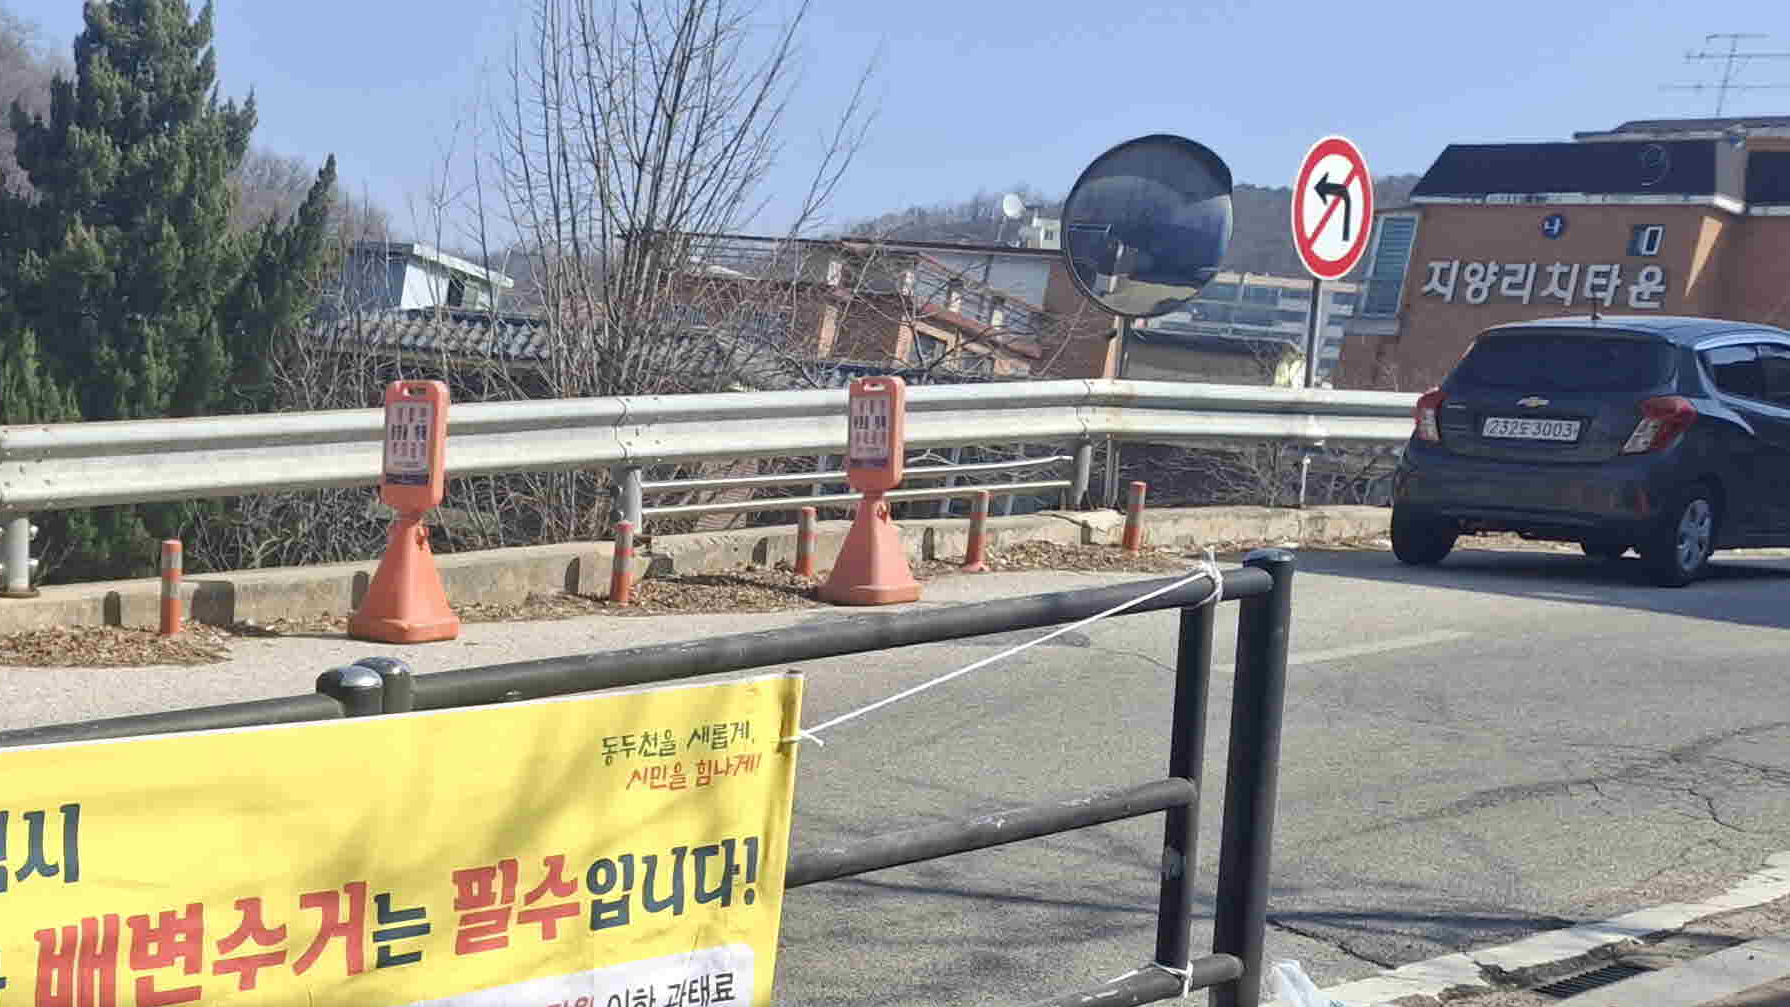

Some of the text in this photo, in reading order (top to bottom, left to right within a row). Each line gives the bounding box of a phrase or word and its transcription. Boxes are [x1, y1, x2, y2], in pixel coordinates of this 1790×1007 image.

[1420, 259, 1667, 310] 지양리치타운
[601, 728, 677, 766] 동두천을
[625, 752, 763, 791] 시민을 힘나게!
[451, 834, 760, 956] 필수입니다!
